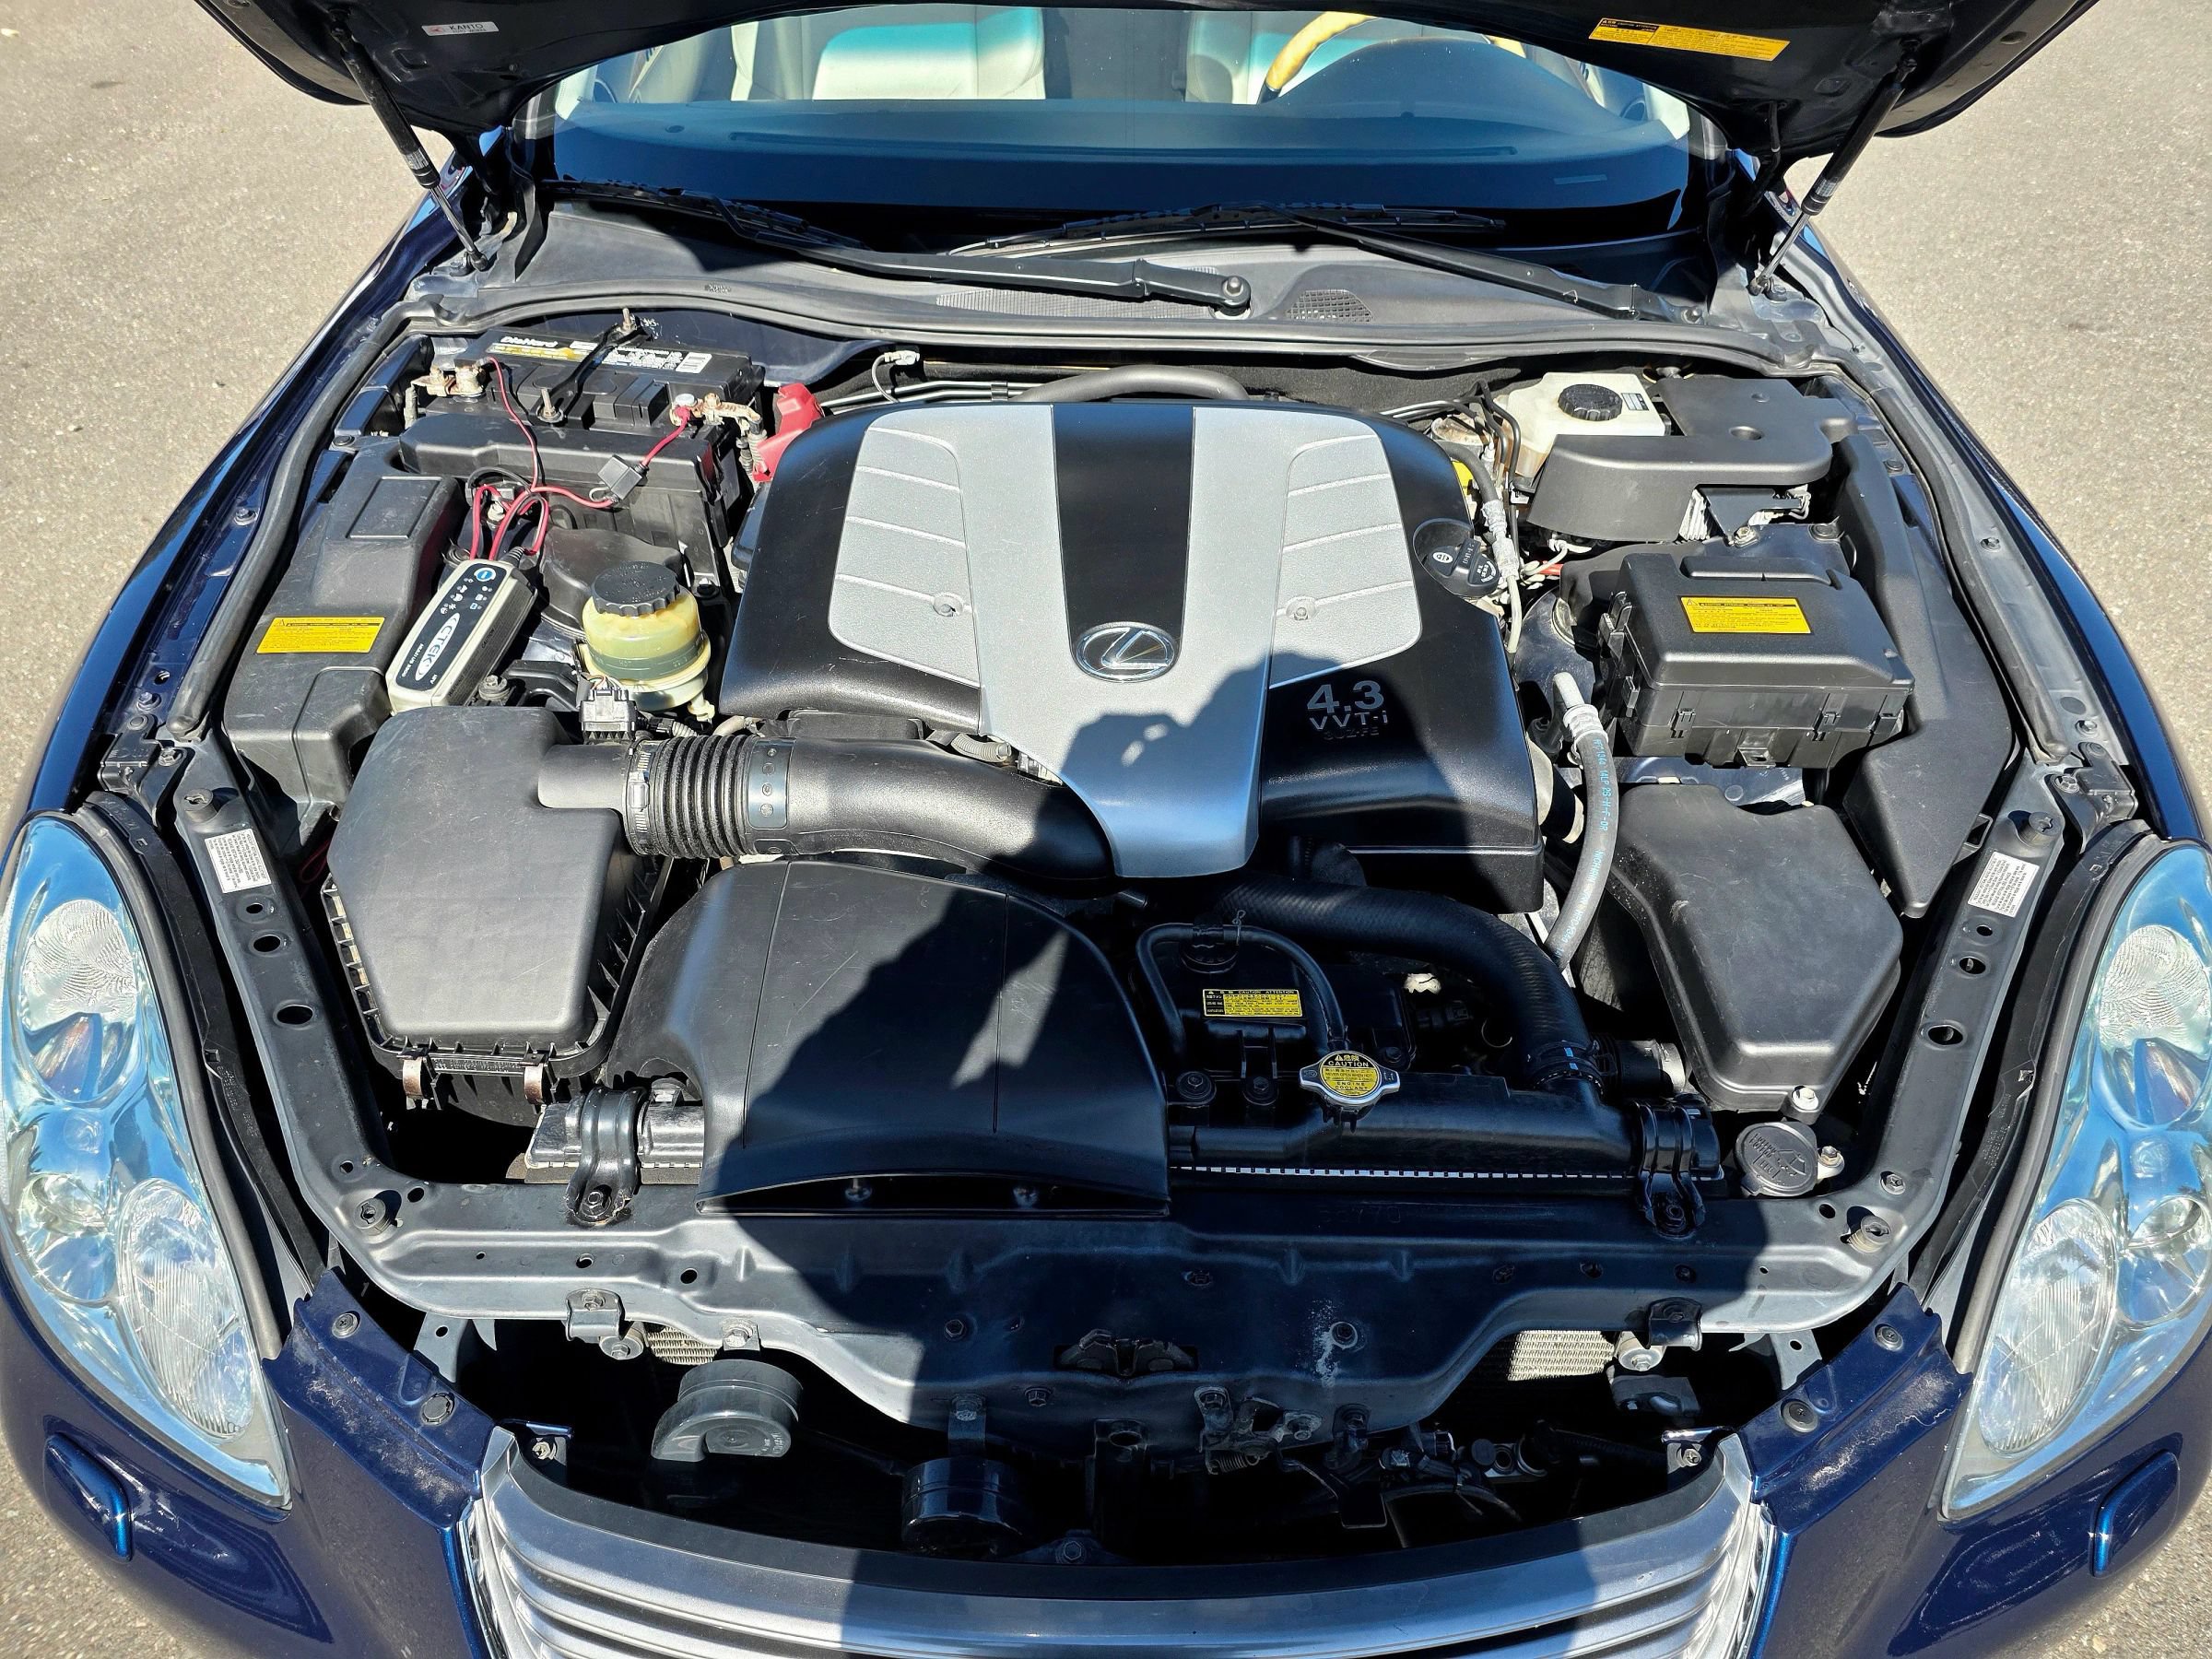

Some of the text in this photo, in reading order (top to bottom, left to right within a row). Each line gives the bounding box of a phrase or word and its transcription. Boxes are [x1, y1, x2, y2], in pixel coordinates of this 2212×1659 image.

[449, 23, 484, 31] KANTO
[423, 625, 453, 665] CTEK
[1307, 680, 1384, 713] 4.3
[1310, 711, 1388, 730] VVT-i
